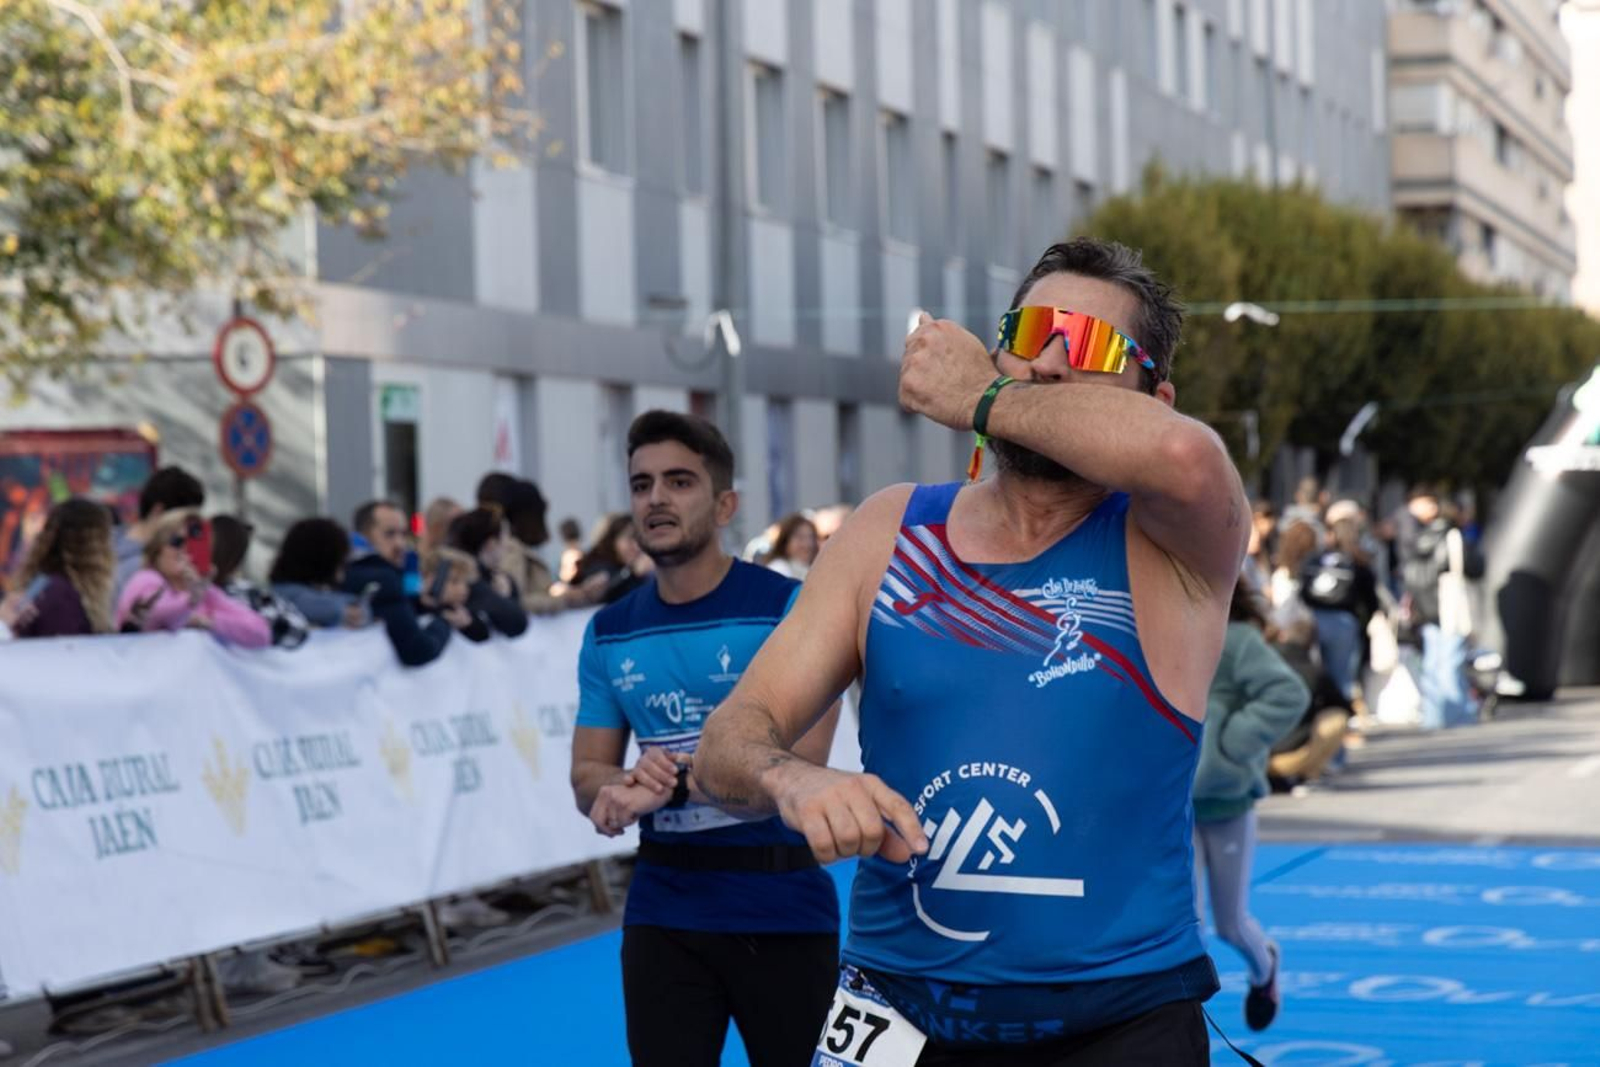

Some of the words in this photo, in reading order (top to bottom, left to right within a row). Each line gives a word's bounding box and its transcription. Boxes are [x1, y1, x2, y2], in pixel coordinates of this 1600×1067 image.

[32, 763, 98, 811] CAJA
[958, 762, 1032, 788] CENTER
[820, 1004, 891, 1063] 57
